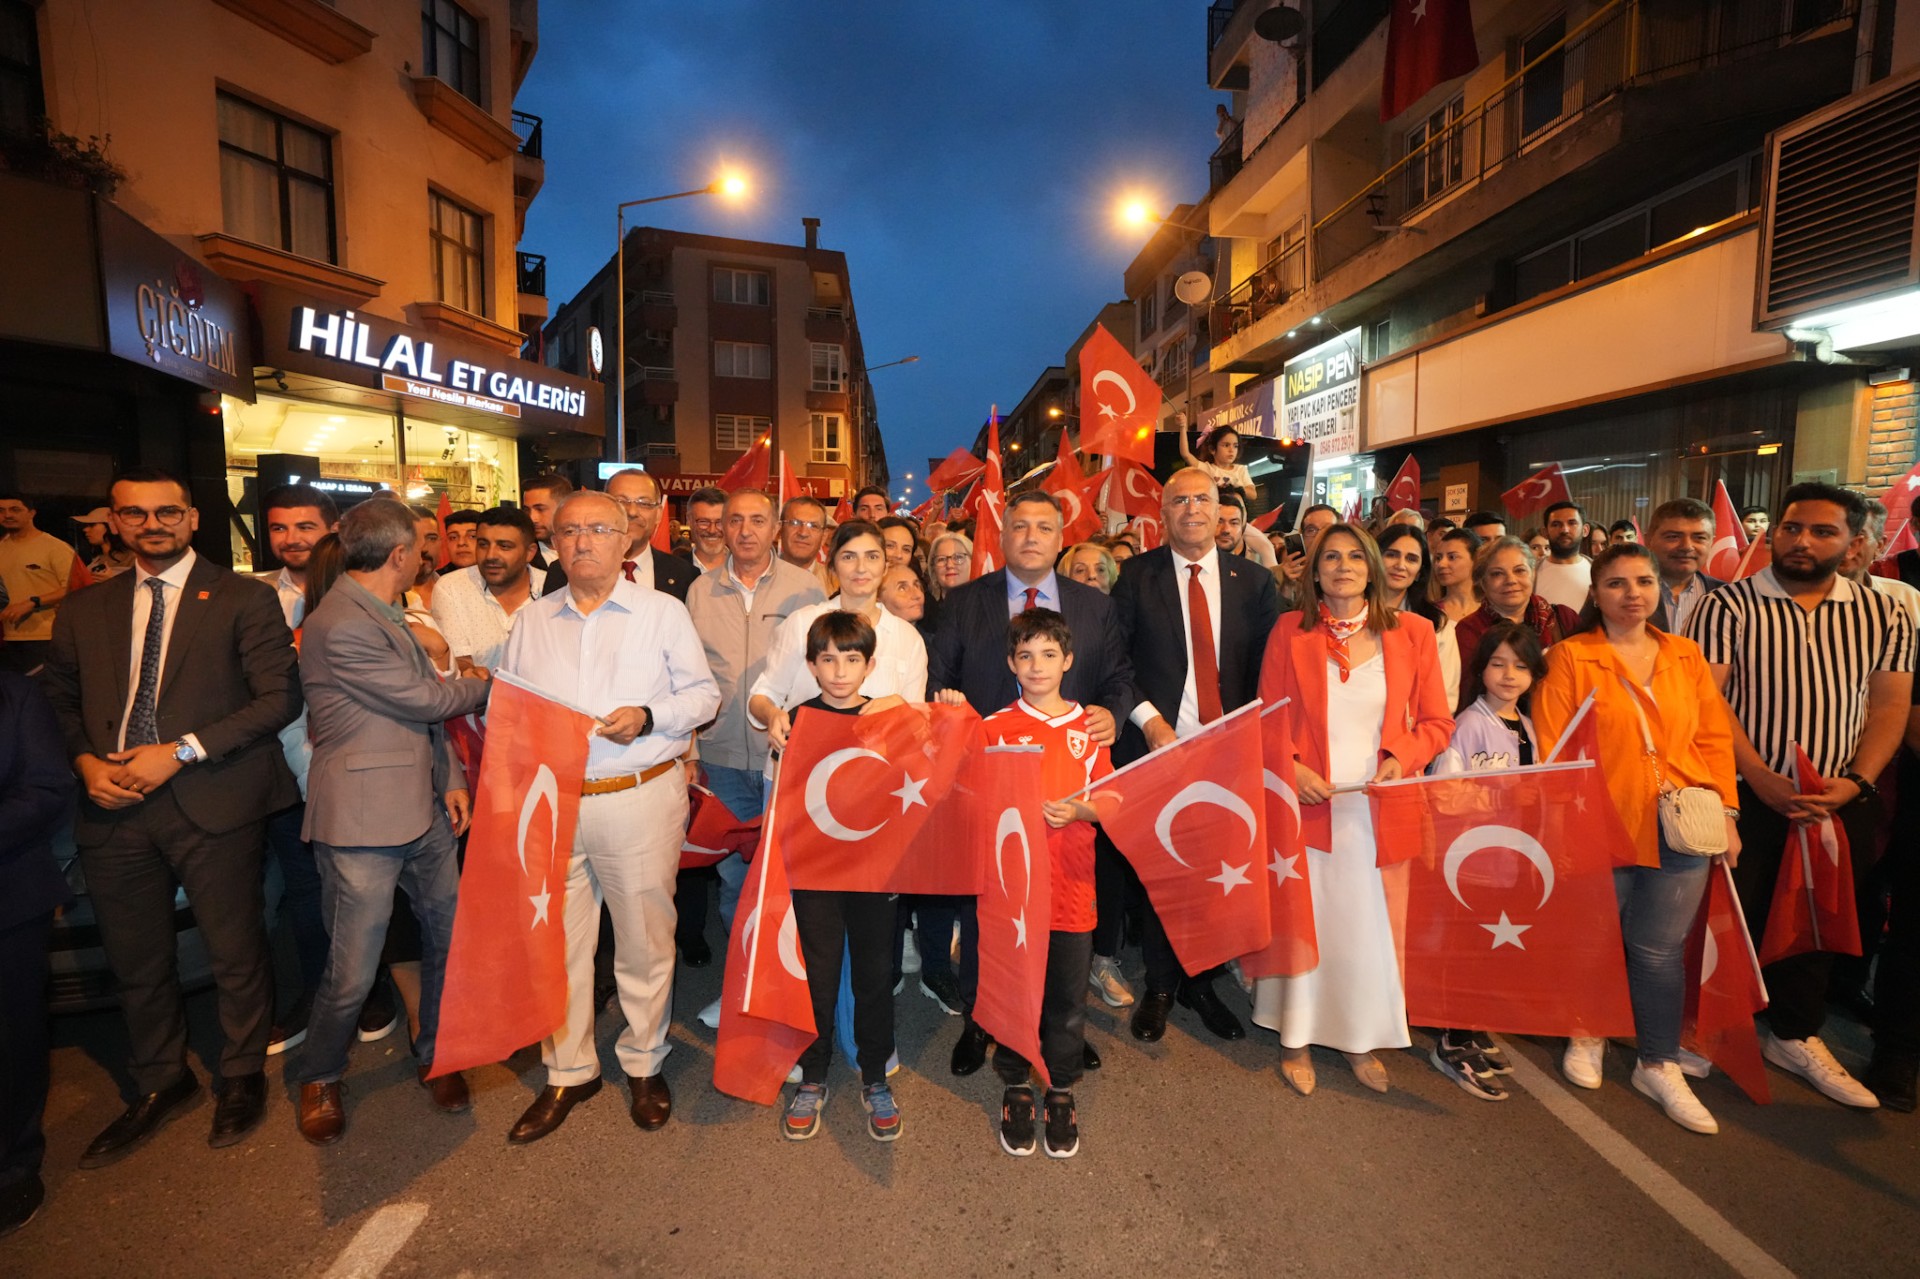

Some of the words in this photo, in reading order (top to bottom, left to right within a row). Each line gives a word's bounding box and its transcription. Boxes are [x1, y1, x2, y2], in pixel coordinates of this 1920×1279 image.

[137, 279, 237, 377] ÇİĞDEM
[300, 306, 442, 382] HİLAL
[452, 360, 486, 391] ET
[489, 371, 586, 417] GALERİSİ
[1326, 348, 1355, 384] PEN
[406, 381, 431, 397] Yeni
[1287, 405, 1299, 424] YAPI
[1300, 401, 1311, 420] PVC
[1312, 396, 1326, 416] KAPI
[1327, 385, 1357, 411] PENCERE
[1303, 412, 1337, 441] SİSTEMLERİ
